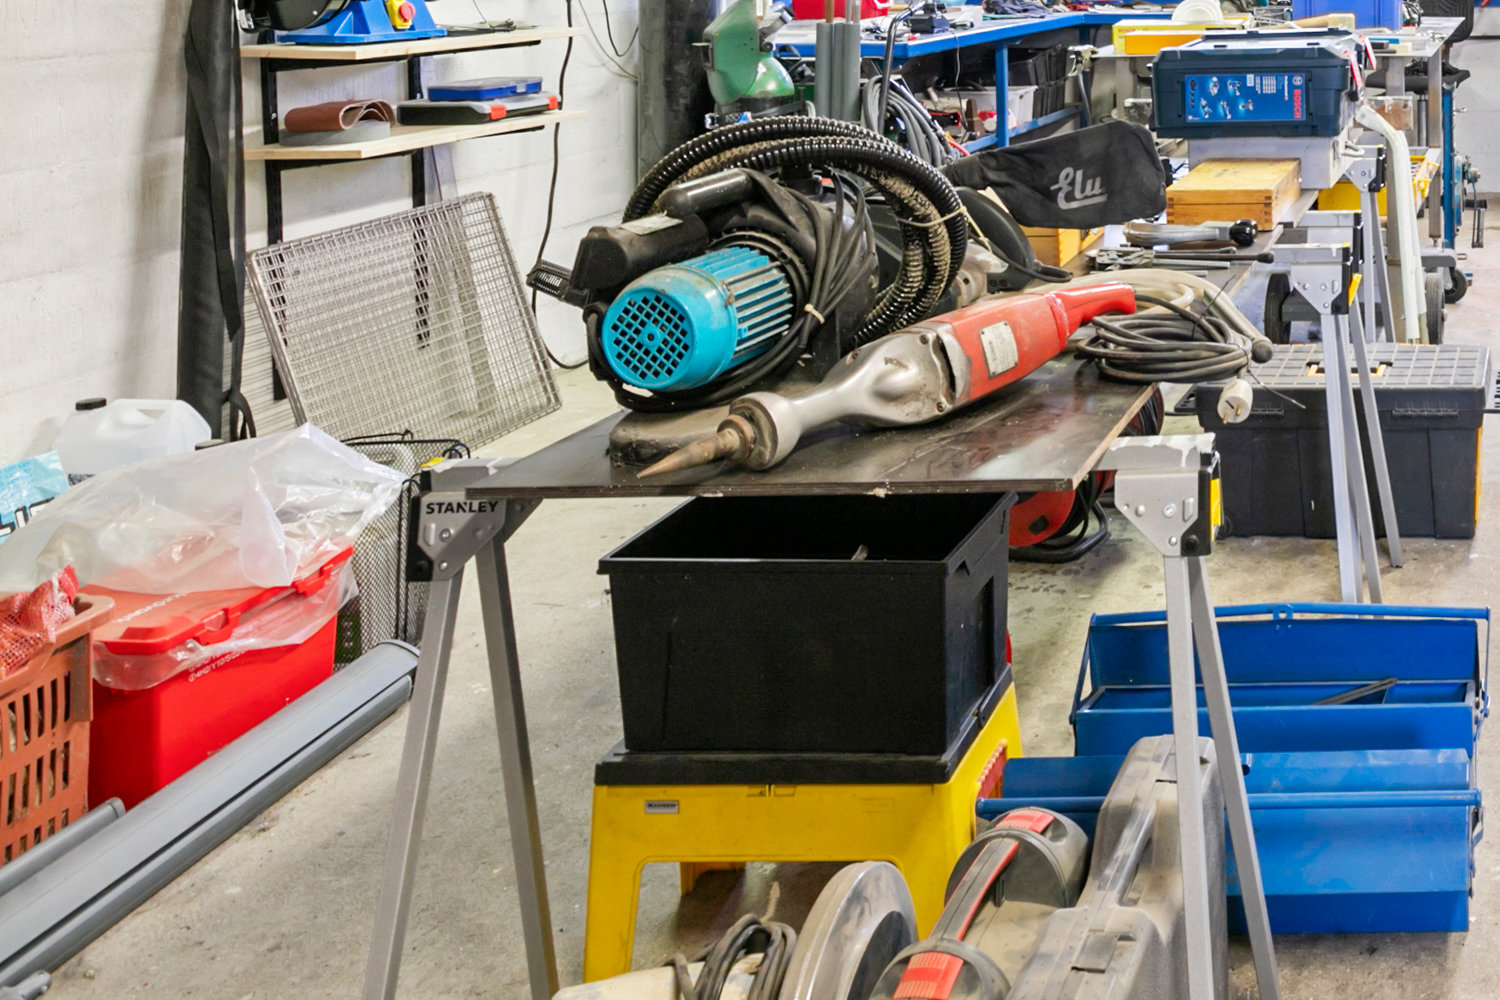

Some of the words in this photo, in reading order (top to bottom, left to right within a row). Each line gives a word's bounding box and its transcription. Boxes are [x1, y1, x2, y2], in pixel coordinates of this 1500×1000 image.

[1293, 89, 1302, 119] BOSCH
[1050, 166, 1108, 211] Elu
[426, 501, 499, 515] STANLEY
